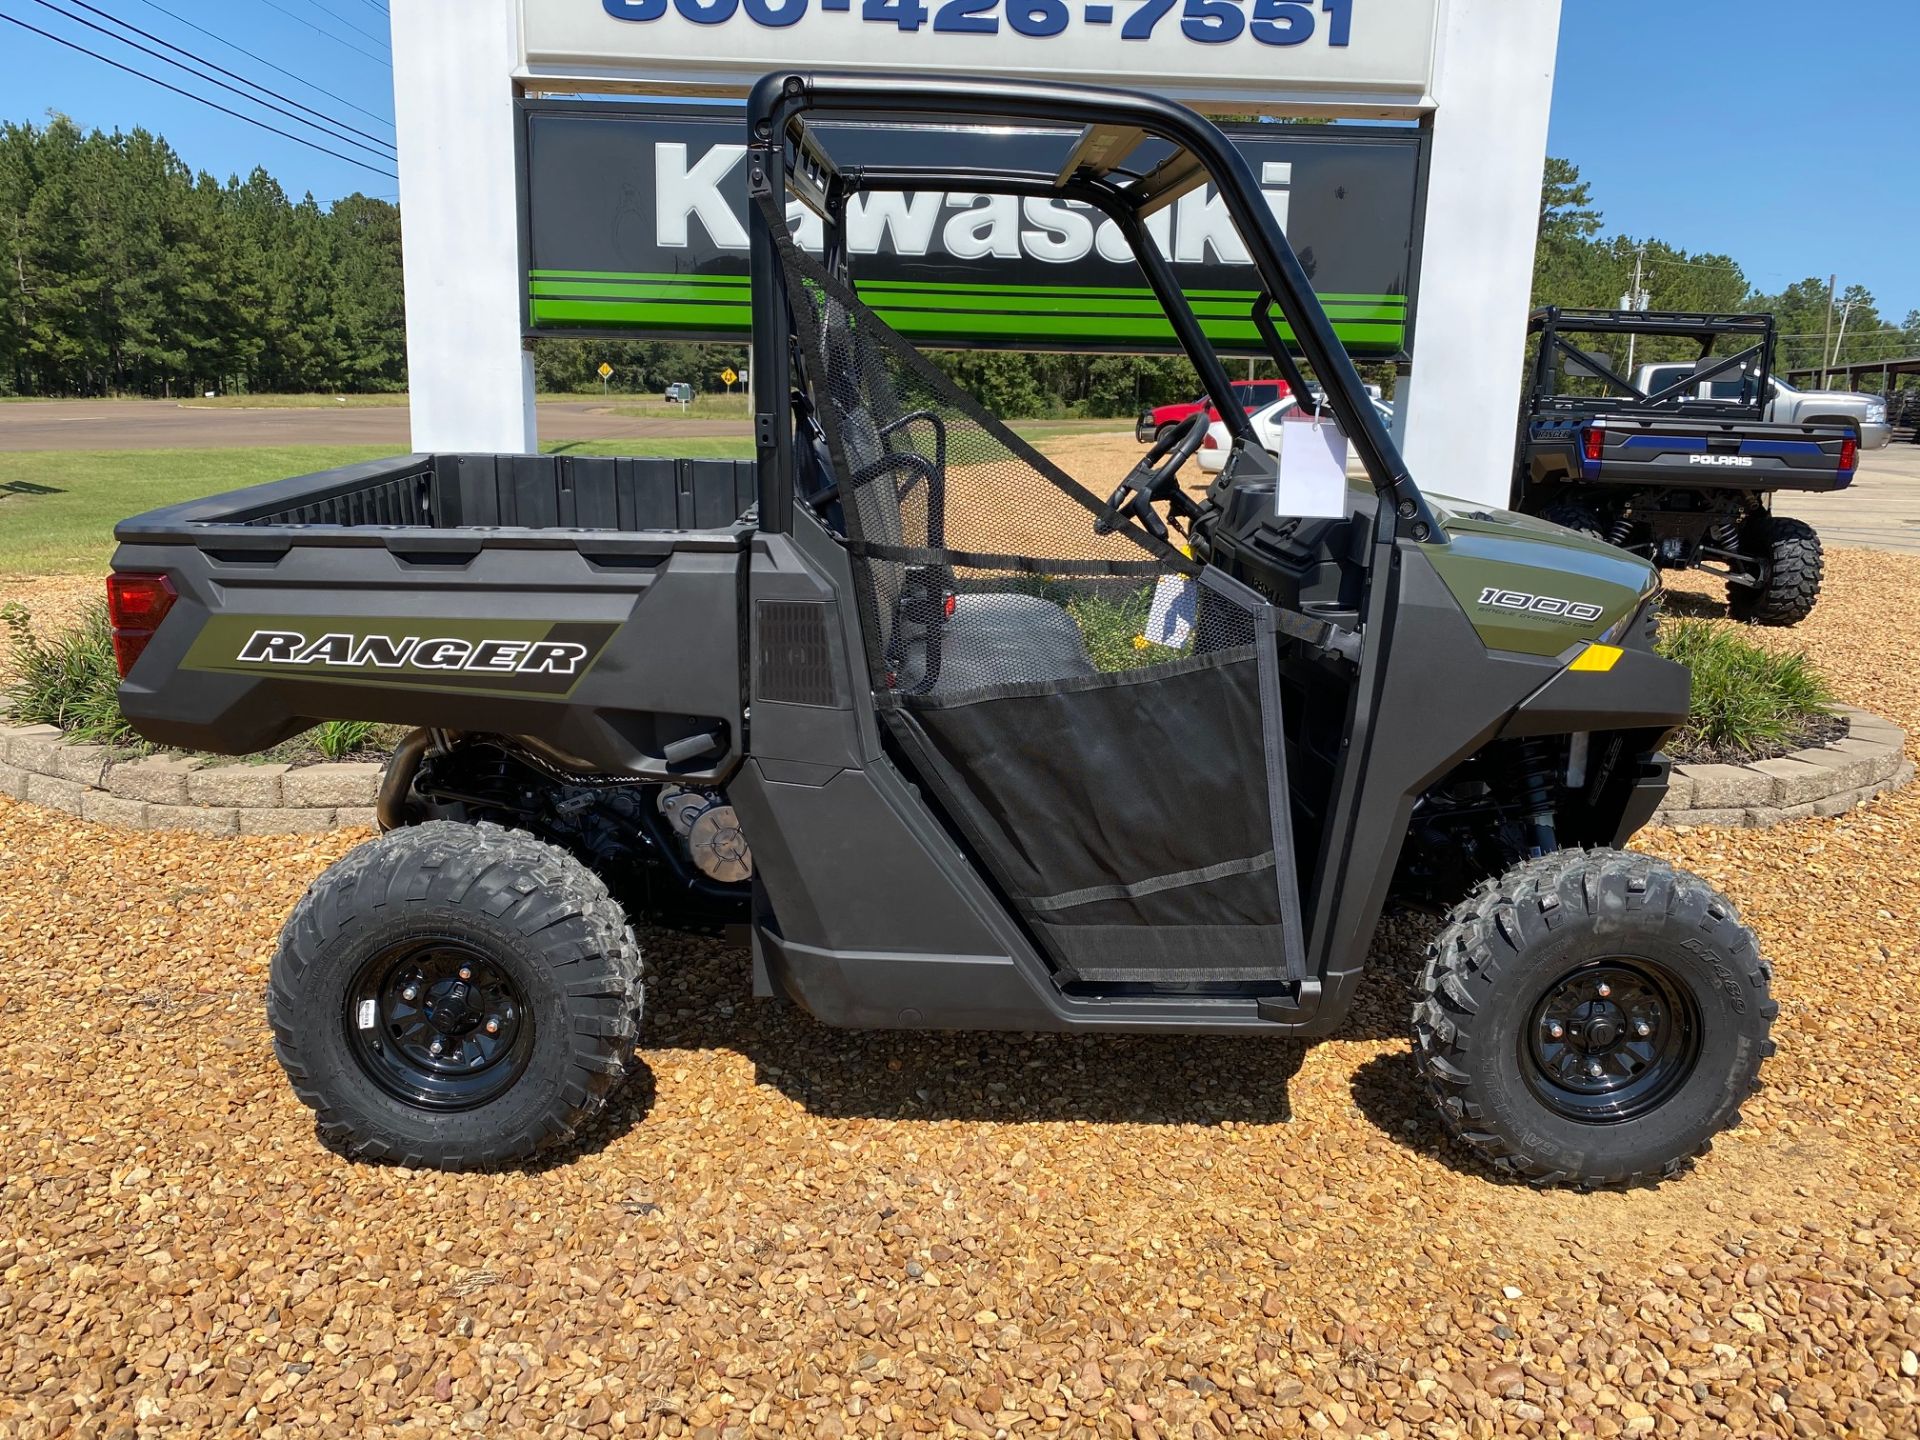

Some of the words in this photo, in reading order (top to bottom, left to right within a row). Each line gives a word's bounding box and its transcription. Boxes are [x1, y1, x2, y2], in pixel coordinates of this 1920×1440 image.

[1689, 454, 1753, 467] POLARIS
[1477, 587, 1603, 621] 1000
[236, 630, 588, 674] RANGER
[1680, 937, 1746, 1015] AT489
